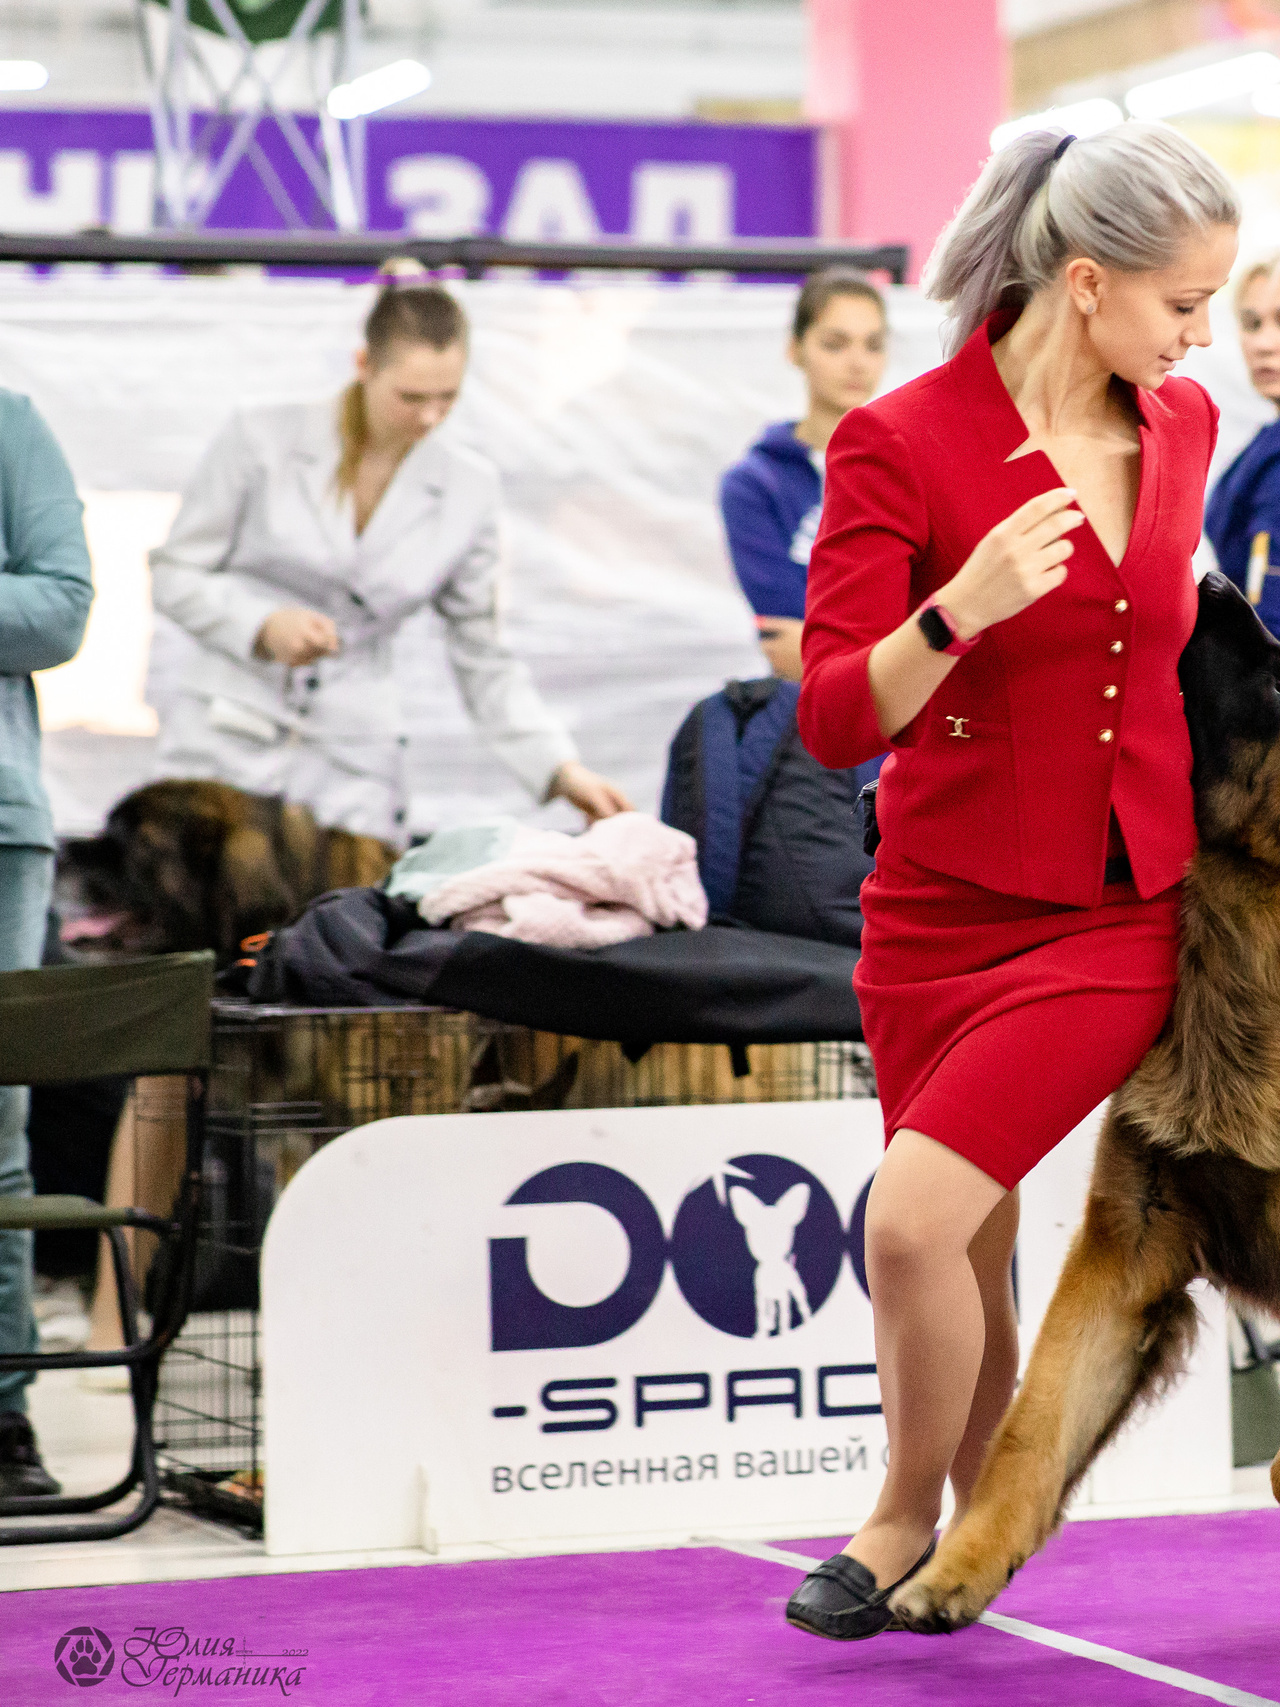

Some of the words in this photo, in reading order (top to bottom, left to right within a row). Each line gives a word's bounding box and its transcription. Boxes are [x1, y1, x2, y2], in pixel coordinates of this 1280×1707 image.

[487, 1153, 1021, 1353] DO
[491, 1363, 884, 1434] -SPAC
[491, 1453, 719, 1493] вселенная
[733, 1435, 868, 1478] вашей
